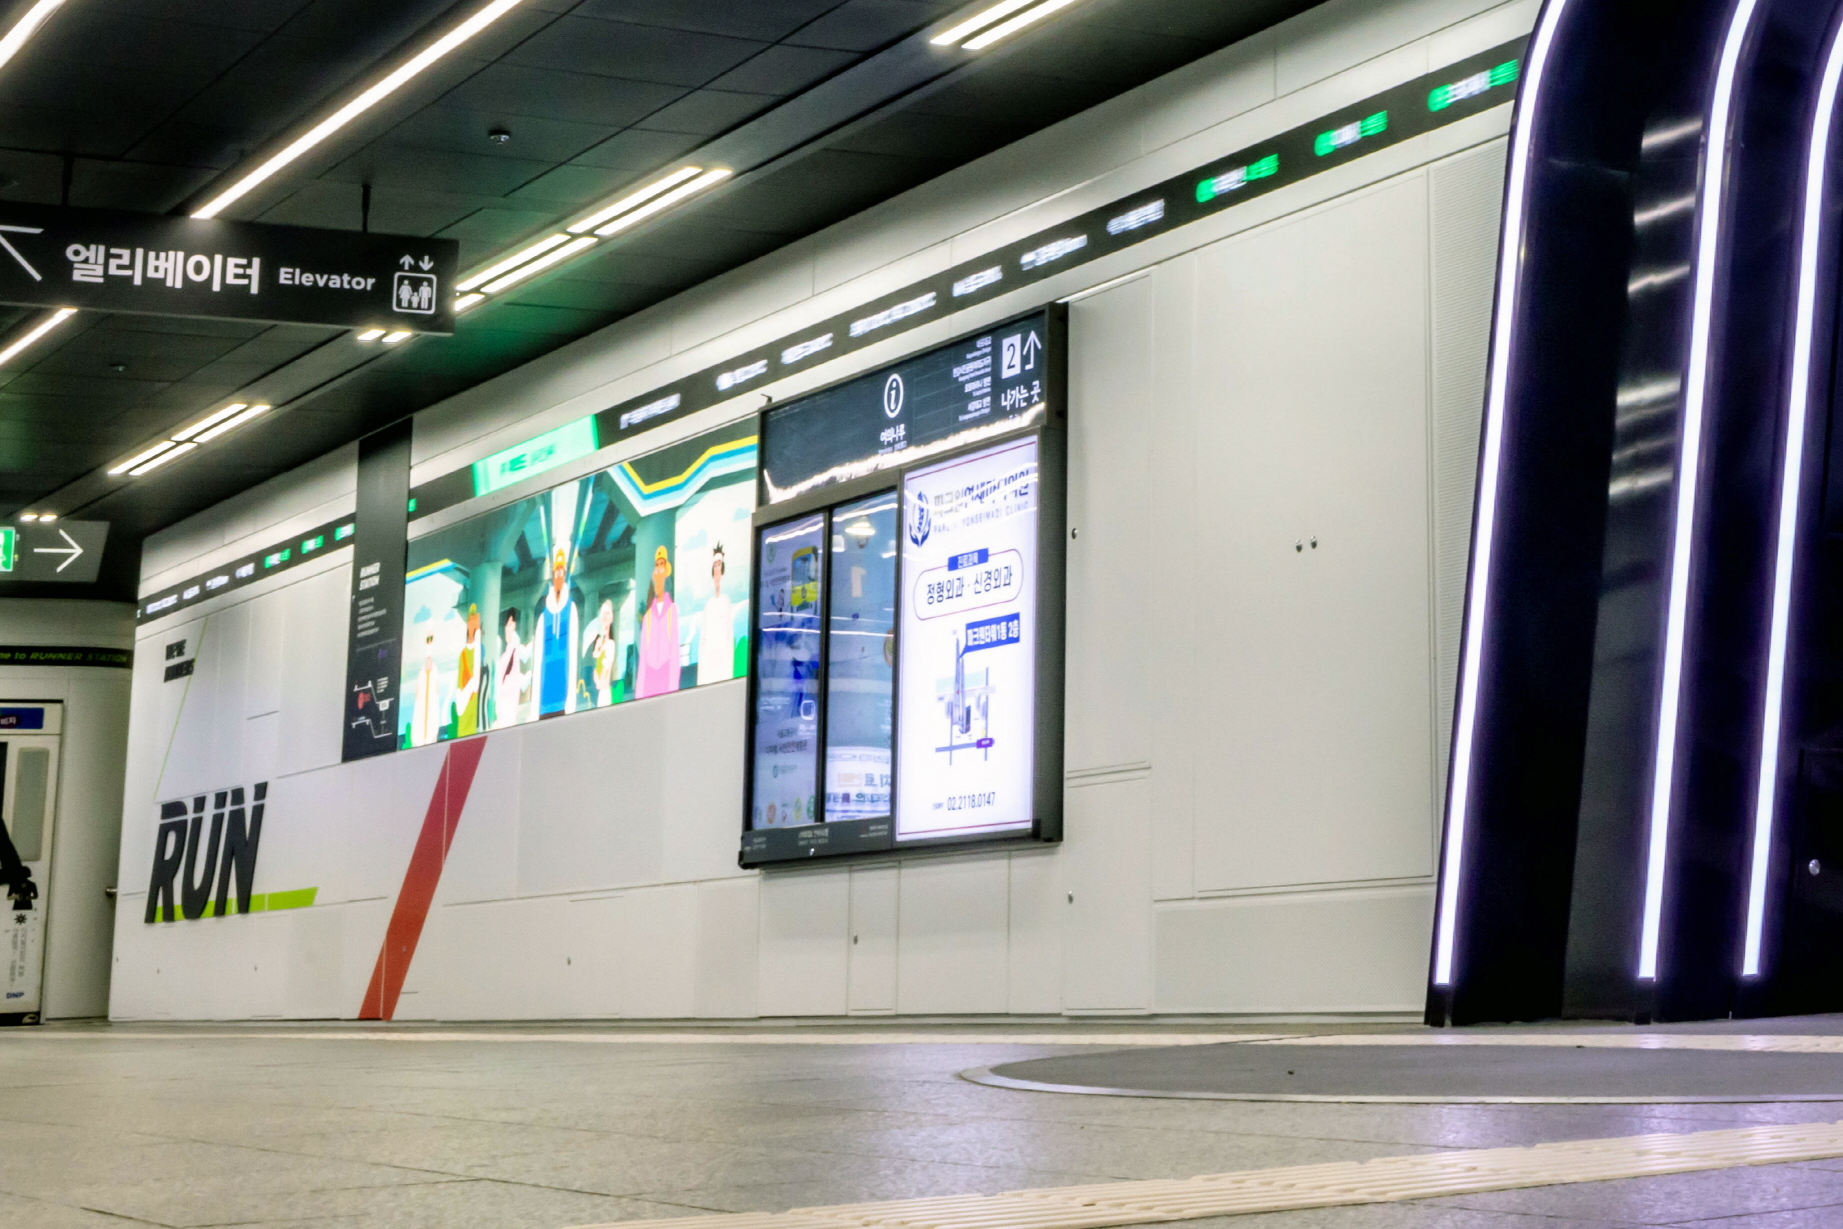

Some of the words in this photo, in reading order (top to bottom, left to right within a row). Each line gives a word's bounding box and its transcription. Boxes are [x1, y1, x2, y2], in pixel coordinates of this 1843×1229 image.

[65, 243, 262, 295] 엘리베이터
[278, 267, 376, 291] Elevator
[1006, 343, 1016, 370] 2
[1001, 385, 1029, 411] 나가는
[1030, 380, 1042, 403] 곳
[880, 423, 906, 446] 여의나루
[927, 576, 965, 605] 정형외과
[974, 565, 1013, 595] 신경외과
[1008, 618, 1019, 638] 2층
[29, 652, 83, 661] RUNNER
[86, 653, 128, 663] STATION
[946, 791, 996, 811] 02.2118.0147
[144, 781, 268, 924] RUN
